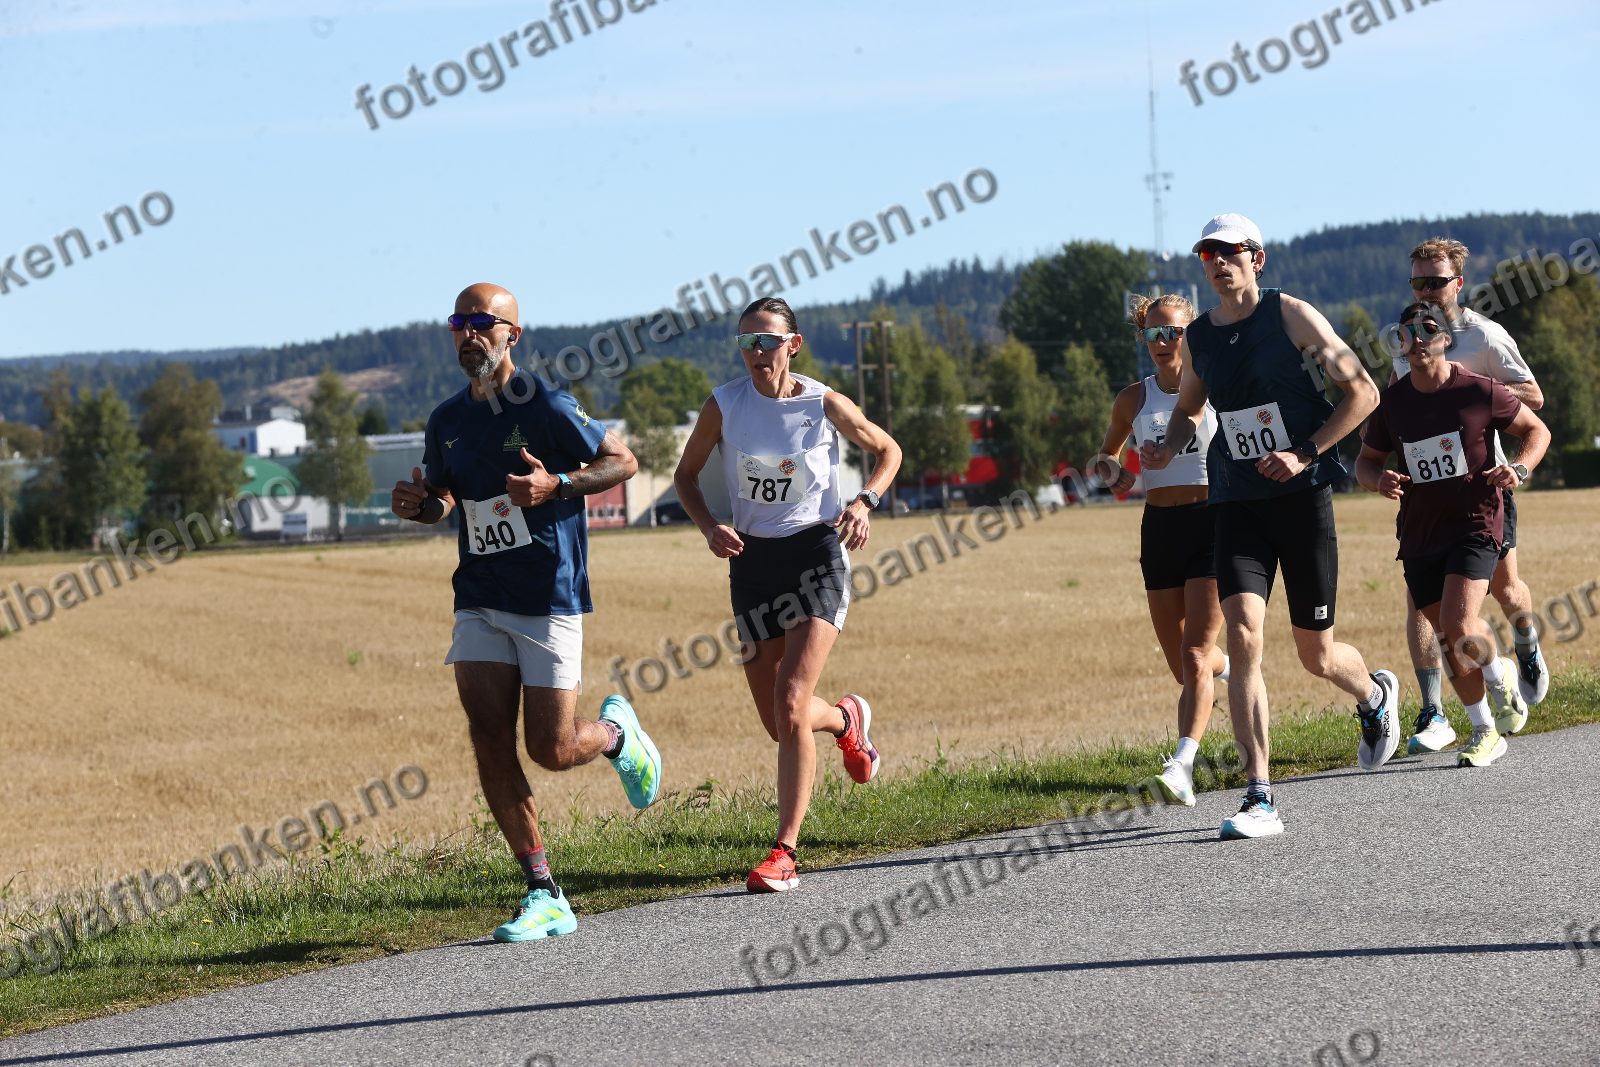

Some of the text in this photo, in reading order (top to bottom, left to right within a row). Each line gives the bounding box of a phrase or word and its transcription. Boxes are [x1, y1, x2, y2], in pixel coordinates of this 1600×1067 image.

[1235, 428, 1277, 457] 810
[1417, 454, 1456, 480] 813
[747, 476, 792, 502] 787
[473, 520, 516, 552] 540
[1382, 710, 1391, 738] HOKA
